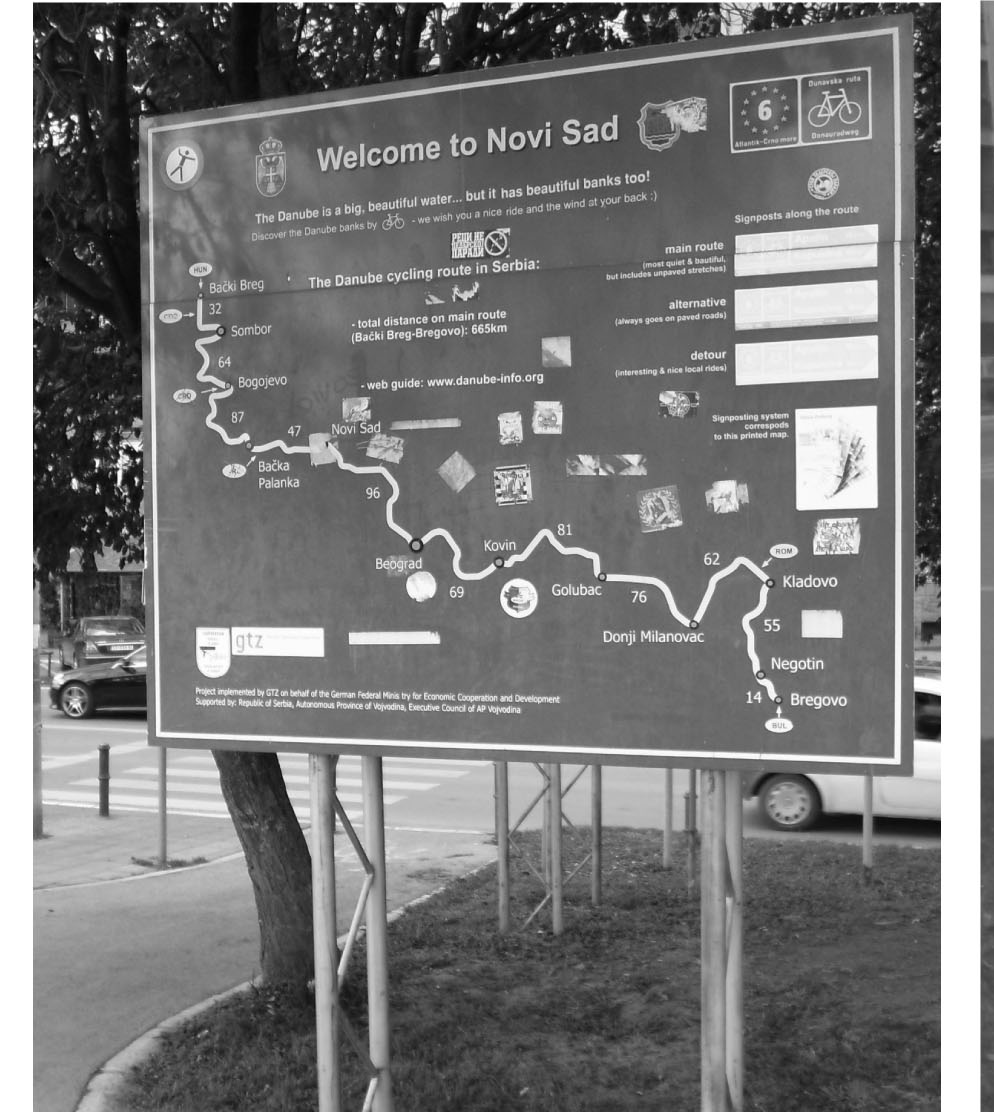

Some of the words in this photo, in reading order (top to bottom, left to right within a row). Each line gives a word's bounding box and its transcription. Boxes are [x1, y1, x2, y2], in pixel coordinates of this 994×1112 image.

[758, 99, 771, 120] 6
[317, 140, 440, 171] Welcome
[449, 133, 477, 156] to
[487, 121, 550, 153] Novi
[562, 114, 617, 145] Sad
[255, 213, 274, 224] The
[278, 208, 319, 221] Danube
[322, 206, 331, 216] is
[335, 207, 340, 215] a
[344, 202, 364, 215] big,
[368, 196, 416, 211] beautiful
[420, 194, 461, 206] water...
[466, 189, 485, 201] but
[488, 188, 496, 198] it
[501, 187, 522, 198] has
[526, 178, 579, 195] beautiful
[583, 175, 621, 188] banks
[625, 170, 649, 184] too!
[734, 212, 782, 224] Signposts
[785, 209, 812, 219] along
[814, 207, 830, 216] the
[833, 206, 859, 214] route
[665, 243, 691, 253] main
[695, 241, 723, 251] route
[308, 276, 331, 288] The
[335, 271, 382, 286] Danube
[386, 268, 432, 284] cycling
[437, 264, 471, 277] route
[476, 263, 487, 274] in
[492, 259, 539, 272] Serbia:
[209, 280, 236, 293] Bački
[240, 279, 264, 291] Breg
[209, 302, 221, 314] 32
[669, 297, 726, 309] alternative
[615, 318, 643, 326] (always
[644, 316, 663, 324] goes
[676, 313, 700, 322] paved
[701, 311, 726, 319] roads)
[231, 323, 271, 336] Sombor
[351, 330, 383, 344] (Bački
[387, 325, 467, 341] Breg-Bregovo):
[471, 324, 507, 334] 665km
[690, 350, 726, 360] detour
[218, 356, 231, 368] 64
[238, 375, 287, 389] Bogojevo
[231, 411, 244, 423] 87
[712, 413, 758, 423] Signposting
[760, 412, 789, 421] system
[287, 425, 301, 436] 47
[331, 421, 355, 434] Novi
[360, 421, 381, 434] Sad
[744, 421, 789, 430] correspods
[740, 431, 767, 440] printed
[769, 431, 788, 439] map.
[258, 459, 289, 472] Bačka
[258, 476, 299, 488] Palanka
[365, 487, 380, 499] 96
[557, 524, 573, 536] 81
[484, 539, 516, 551] Kovin
[375, 557, 423, 573] Beograd
[703, 552, 719, 565] 62
[783, 574, 837, 587] Kladovo
[449, 586, 464, 598] 69
[551, 583, 601, 596] Golubac
[631, 590, 646, 602] 76
[764, 619, 780, 631] 55
[236, 632, 263, 653] gtz
[603, 630, 635, 645] Donji
[640, 630, 704, 642] Milanovac
[771, 657, 823, 673] Negotin
[746, 691, 761, 703] 14
[790, 693, 847, 709] Bregovo
[195, 697, 225, 706] Supported
[227, 699, 236, 707] by:
[238, 698, 263, 707] Republic
[265, 699, 271, 707] of
[273, 699, 294, 708] Serbia,
[295, 700, 334, 709] Autonomous
[336, 701, 363, 709] Province
[364, 701, 371, 709] of
[373, 702, 406, 711] Vojvodina,
[408, 702, 440, 711] Executive
[441, 703, 466, 712] Council
[467, 704, 475, 712] of
[476, 704, 486, 712] AP
[487, 705, 521, 714] Vojvodina
